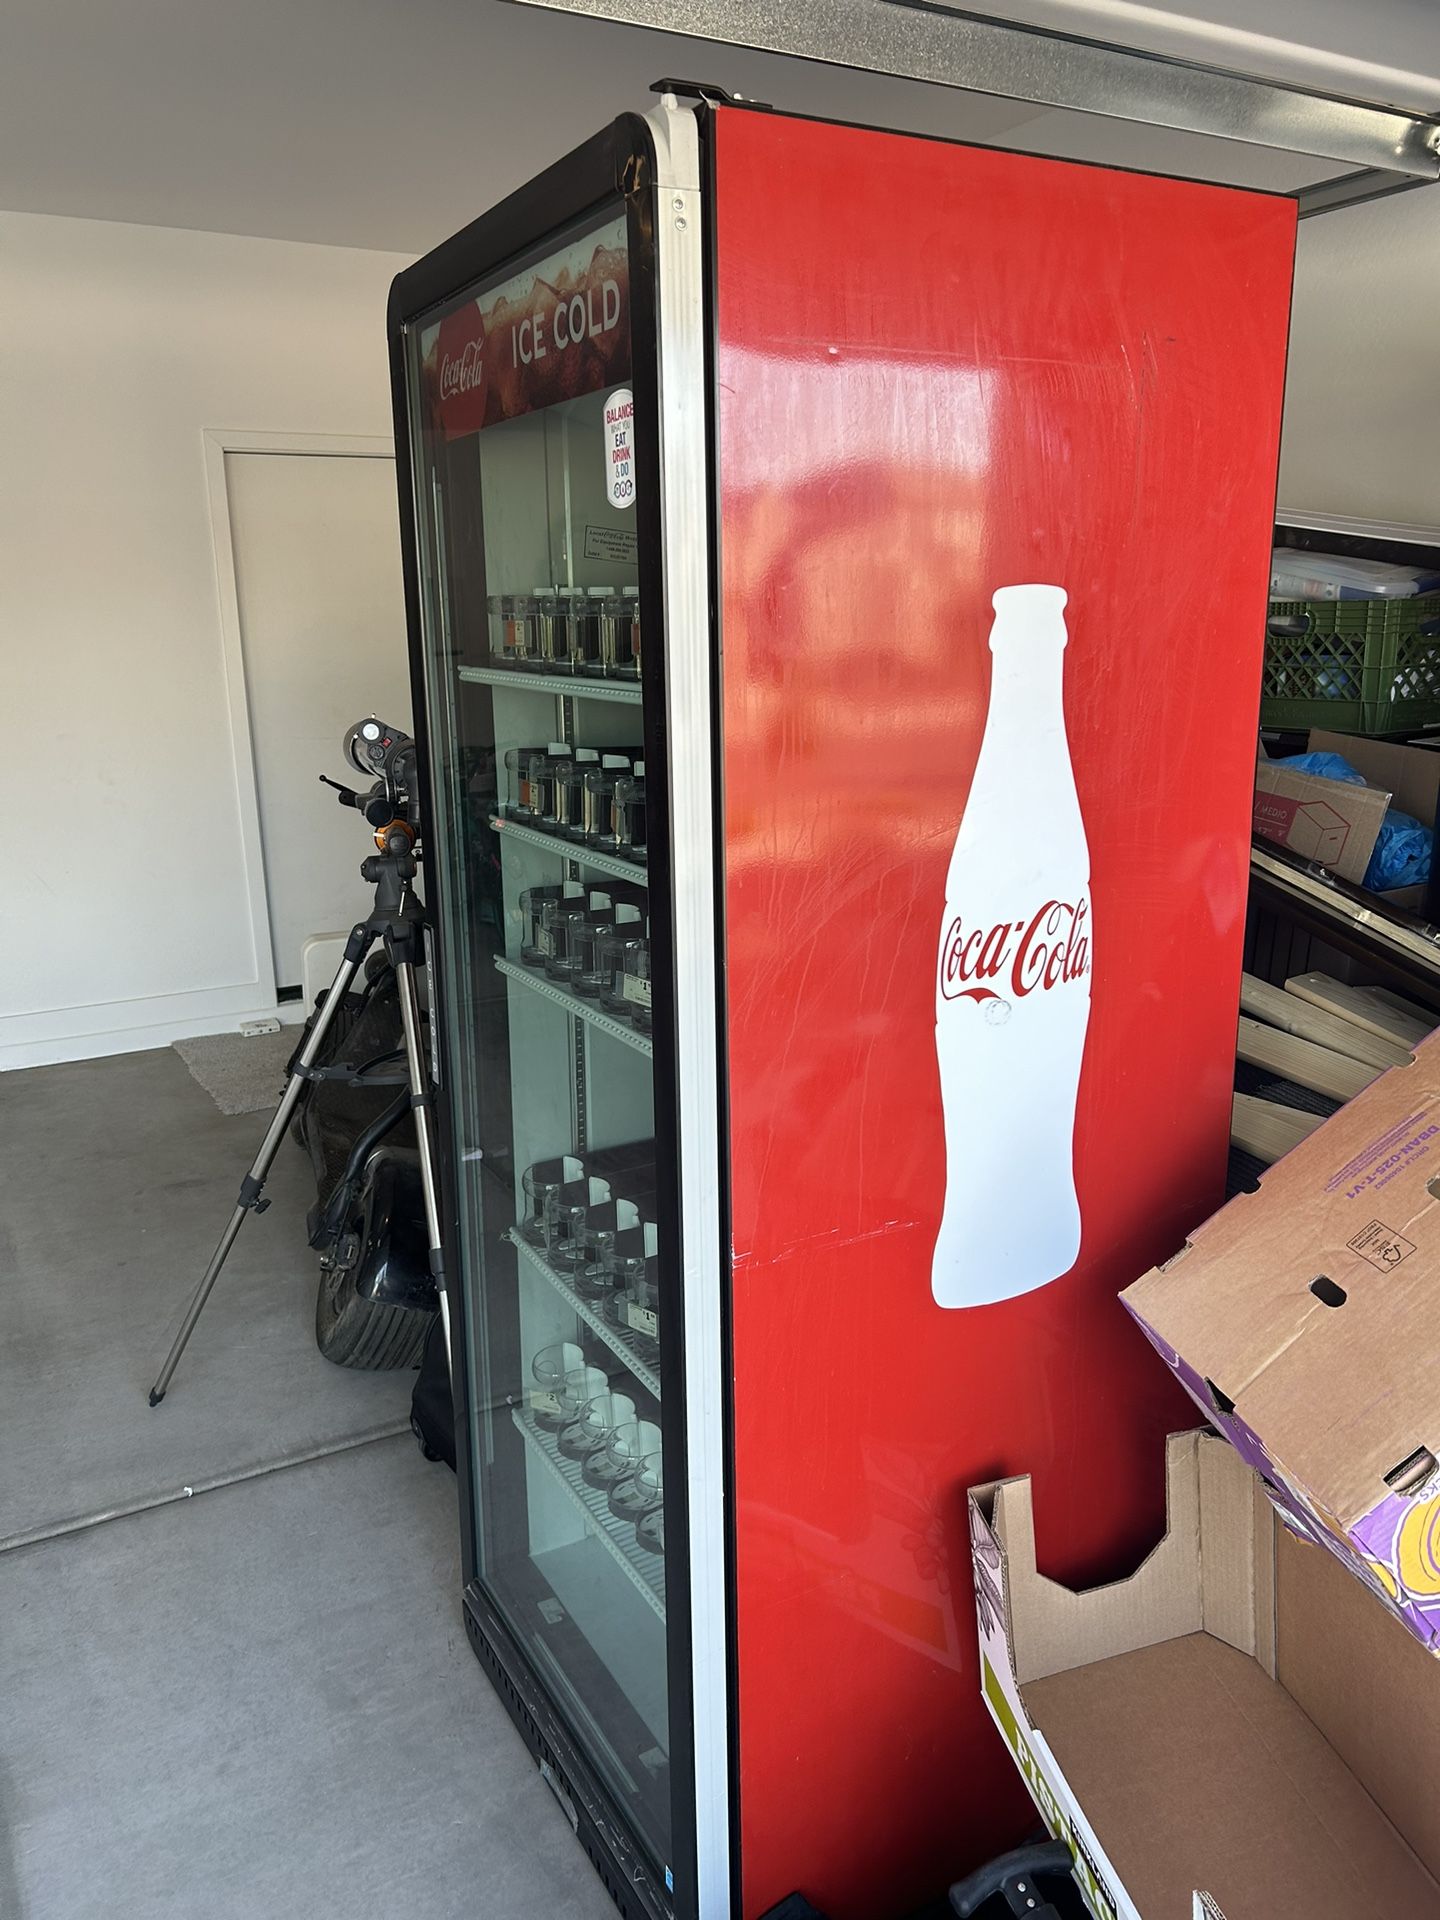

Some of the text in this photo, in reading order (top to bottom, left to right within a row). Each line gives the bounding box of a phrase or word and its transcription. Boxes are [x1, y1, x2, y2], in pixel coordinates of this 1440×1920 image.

[512, 278, 621, 369] ICE COLD
[440, 337, 484, 401] Coca-Cola
[606, 401, 634, 424] BALANCE
[610, 420, 631, 434] WHAT YOU
[615, 431, 627, 447] EAT
[612, 446, 632, 465] DRINK
[620, 461, 629, 477] DO
[1262, 803, 1288, 820] MEDIO
[940, 897, 1089, 1005] Coca-Cola
